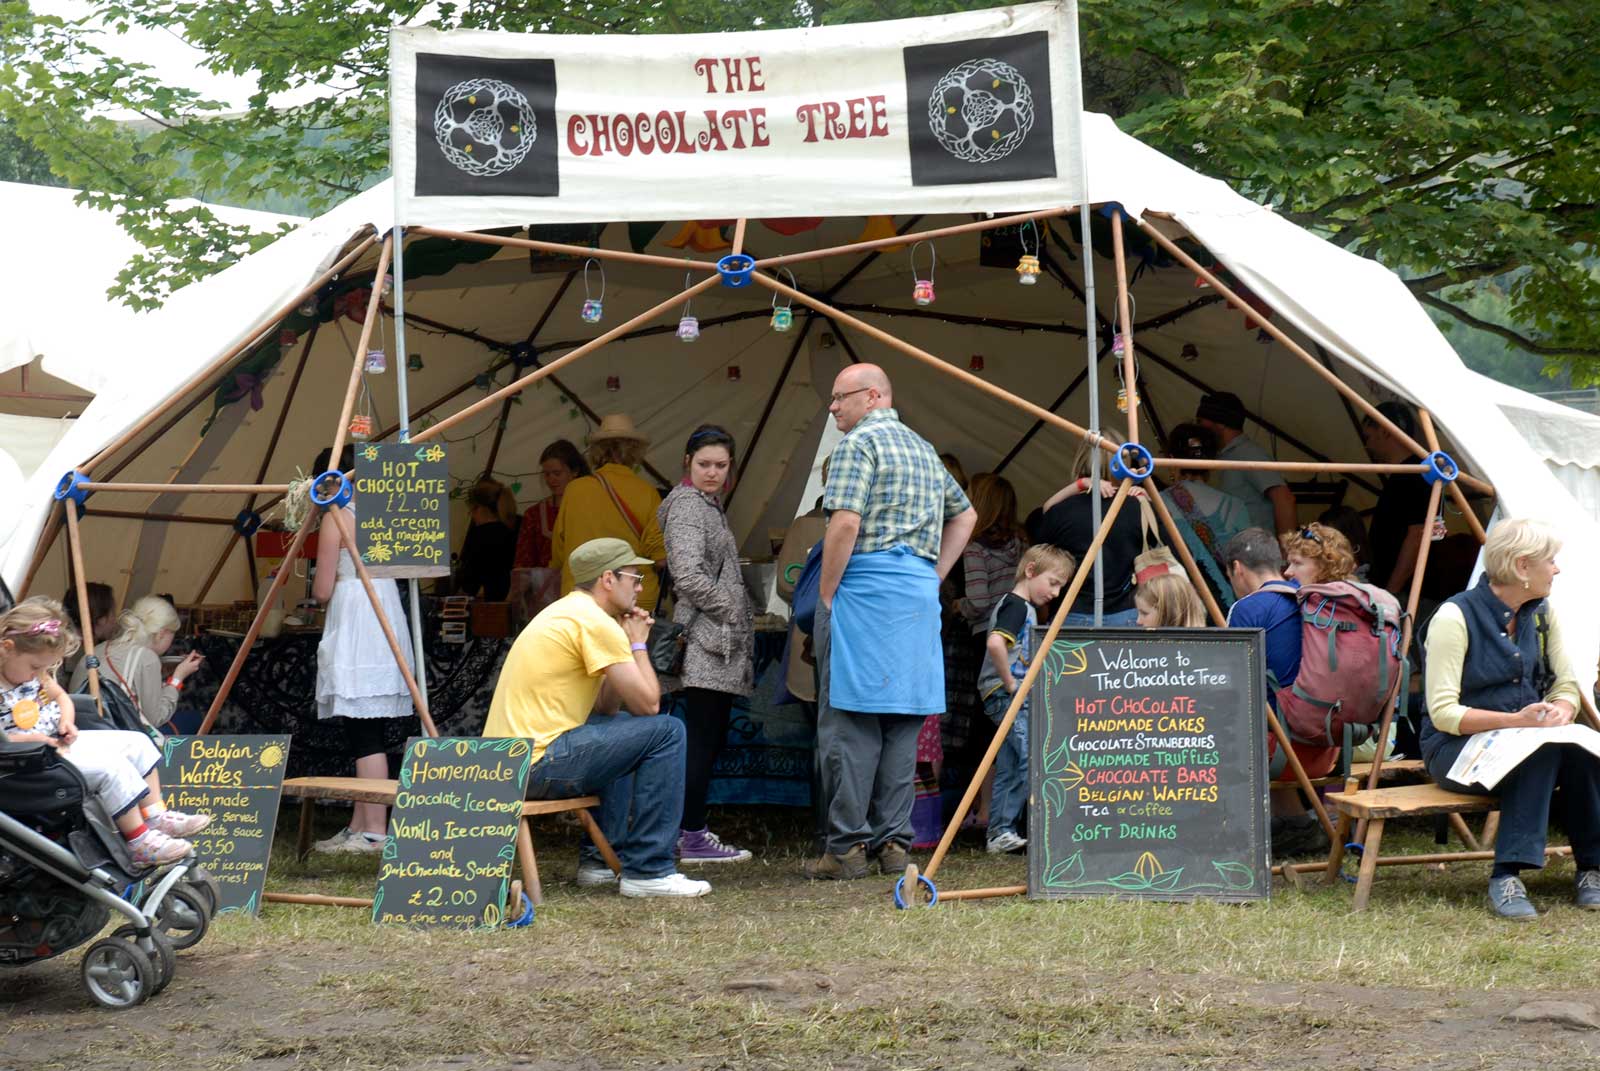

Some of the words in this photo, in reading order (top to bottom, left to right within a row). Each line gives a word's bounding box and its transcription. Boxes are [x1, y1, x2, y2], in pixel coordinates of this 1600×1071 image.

[695, 56, 765, 93] THE
[567, 108, 769, 157] CHOCOLATE
[797, 95, 889, 143] TREE
[382, 461, 420, 477] HOT
[356, 479, 446, 494] CHOCOLATE
[361, 517, 385, 529] add
[391, 518, 440, 530] cream
[369, 528, 393, 541] and
[392, 541, 411, 556] for
[412, 544, 443, 564] 20p
[1098, 648, 1169, 670] Welcome
[1175, 651, 1191, 667] to
[1090, 672, 1121, 691] The
[1123, 670, 1195, 689] Chocolate
[1193, 668, 1227, 685] Tree
[1077, 718, 1153, 733] HANDMADE
[1157, 716, 1206, 733] CAKES
[1069, 734, 1133, 751] CHOCOLATE
[1134, 733, 1216, 751] STRAWBERRIES
[190, 740, 252, 768] Belgian
[1079, 753, 1150, 767] HANDMADE
[180, 763, 243, 786] Waffles
[411, 761, 514, 785] Homemade
[1086, 768, 1169, 785] CHOCOLATE
[1177, 766, 1217, 784] BARS
[166, 793, 176, 809] A
[178, 792, 209, 808] fresh
[212, 796, 250, 808] made
[1152, 785, 1219, 802] WAFFLES
[396, 791, 462, 810] Chocolate
[463, 793, 486, 813] Ice
[486, 798, 524, 818] Cream
[1080, 804, 1110, 817] Tea
[1128, 802, 1174, 817] Coffee
[222, 811, 259, 824] served
[232, 827, 264, 838] sauce
[391, 817, 440, 842] Vanilla
[443, 820, 469, 840] Ice
[469, 823, 519, 843] cream
[429, 846, 455, 864] and
[379, 862, 407, 882] Dark
[406, 861, 465, 878] Chocolate
[464, 860, 512, 882] Sorbet
[441, 914, 452, 923] or
[455, 914, 476, 925] cup
